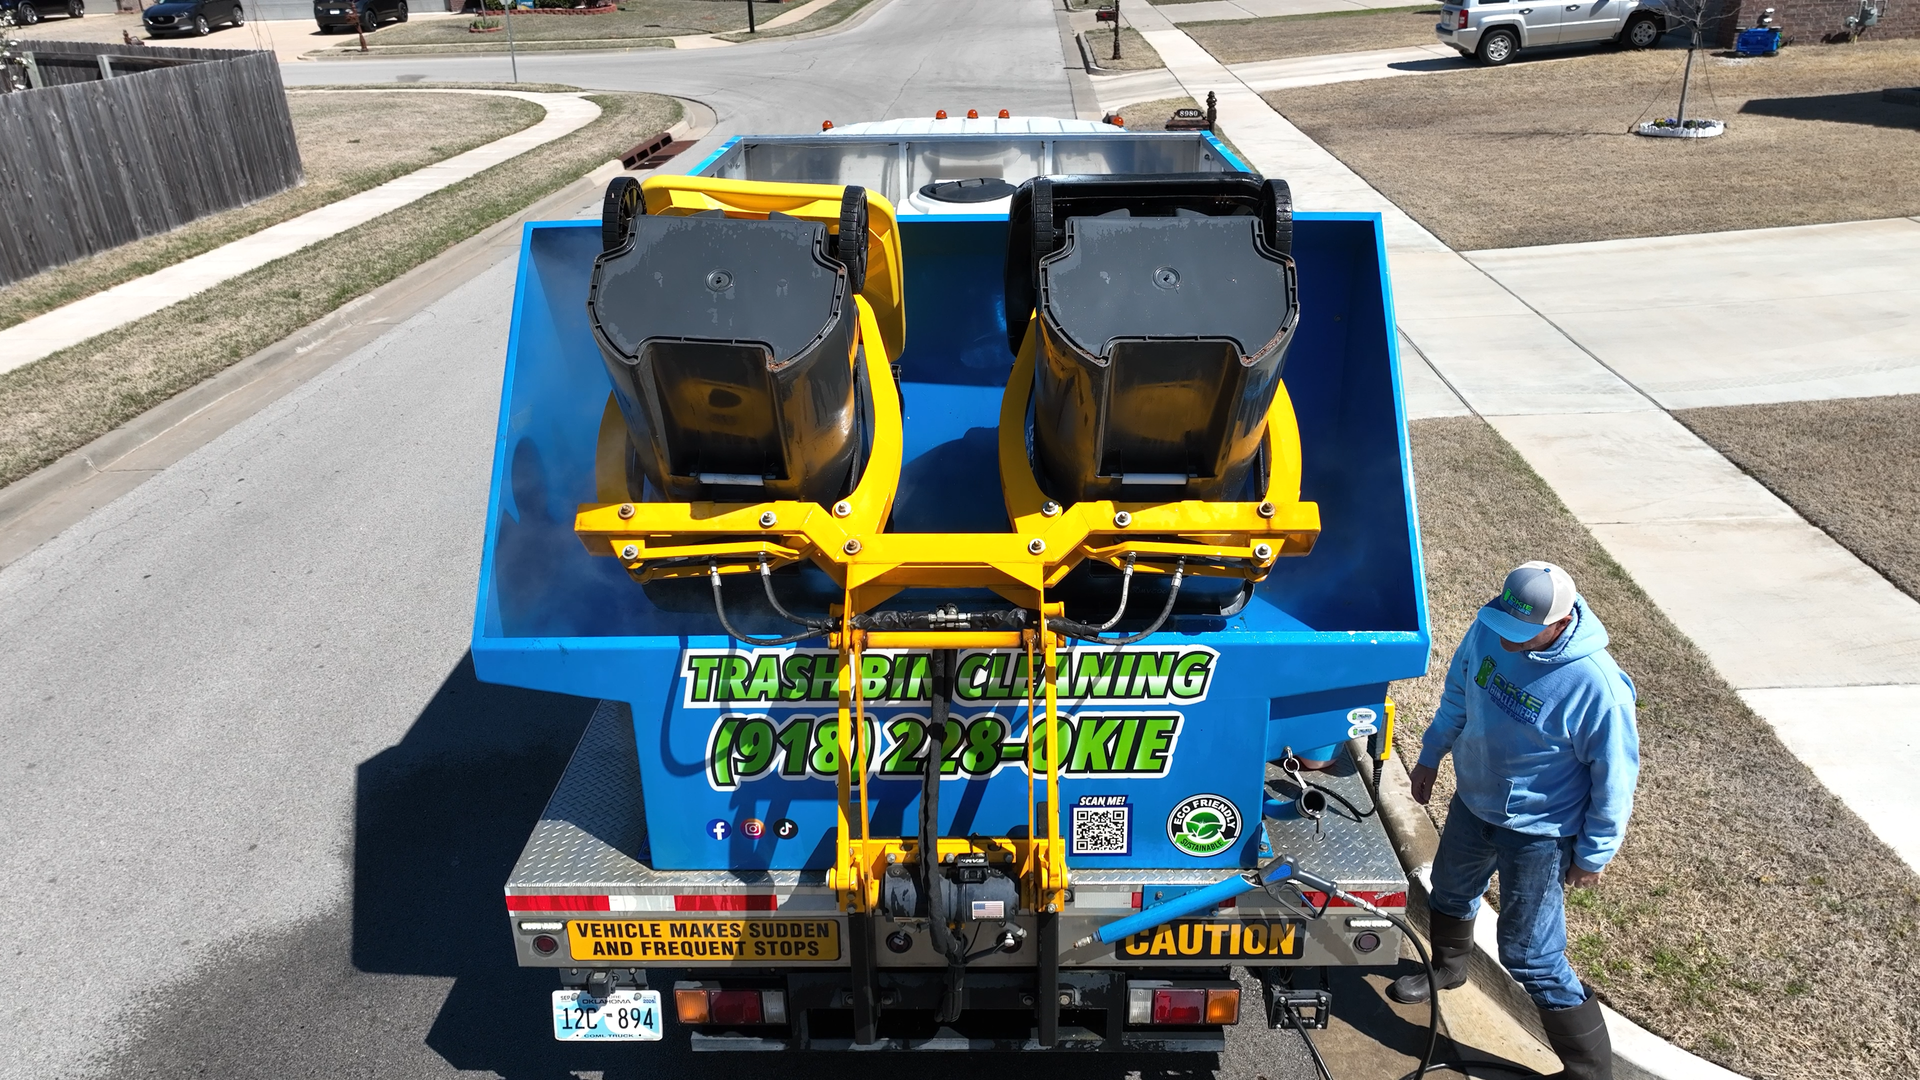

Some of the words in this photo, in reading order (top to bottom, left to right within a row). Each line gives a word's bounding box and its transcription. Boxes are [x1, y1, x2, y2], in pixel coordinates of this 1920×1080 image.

[955, 651, 1214, 700] CLEANING
[879, 716, 1180, 775] 228-OKIE
[1080, 796, 1105, 806] SCAN
[1107, 796, 1126, 806] ME!
[1173, 805, 1191, 825] ECO
[1192, 799, 1236, 829] FRIENDLY
[1180, 838, 1224, 852] SUSTAINABLE
[576, 923, 662, 938] VEHICLE
[669, 923, 742, 938] MAKES
[748, 923, 830, 938] SUDDEN
[1125, 923, 1296, 956] CAUTION
[593, 941, 633, 956] AND
[641, 941, 747, 957] FREQUENT
[754, 941, 820, 956] STOPS
[562, 1007, 598, 1029] 12C
[618, 1007, 654, 1029] 894
